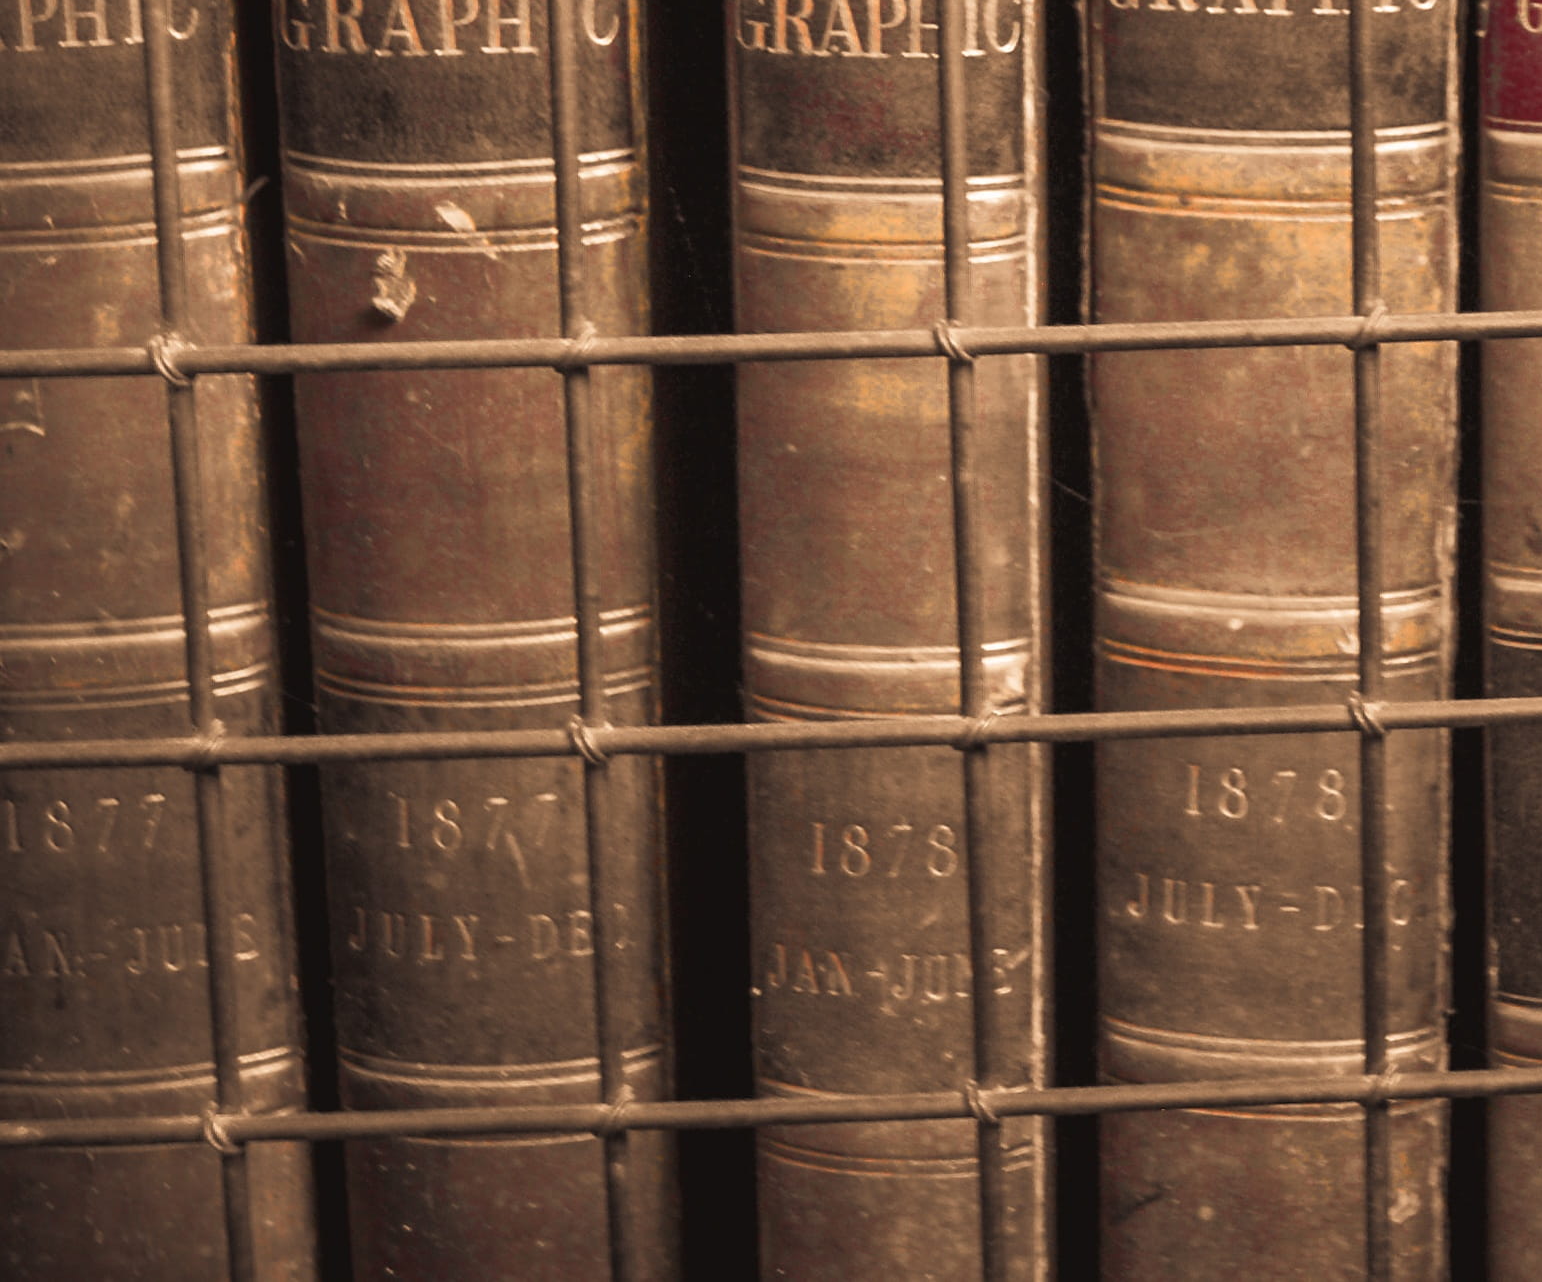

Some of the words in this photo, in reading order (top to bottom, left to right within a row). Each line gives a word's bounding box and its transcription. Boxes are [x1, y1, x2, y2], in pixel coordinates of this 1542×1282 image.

[387, 791, 558, 850] 1877
[1184, 765, 1346, 823] 1878
[811, 822, 958, 878] 1878
[349, 902, 636, 961] JULY-DE
